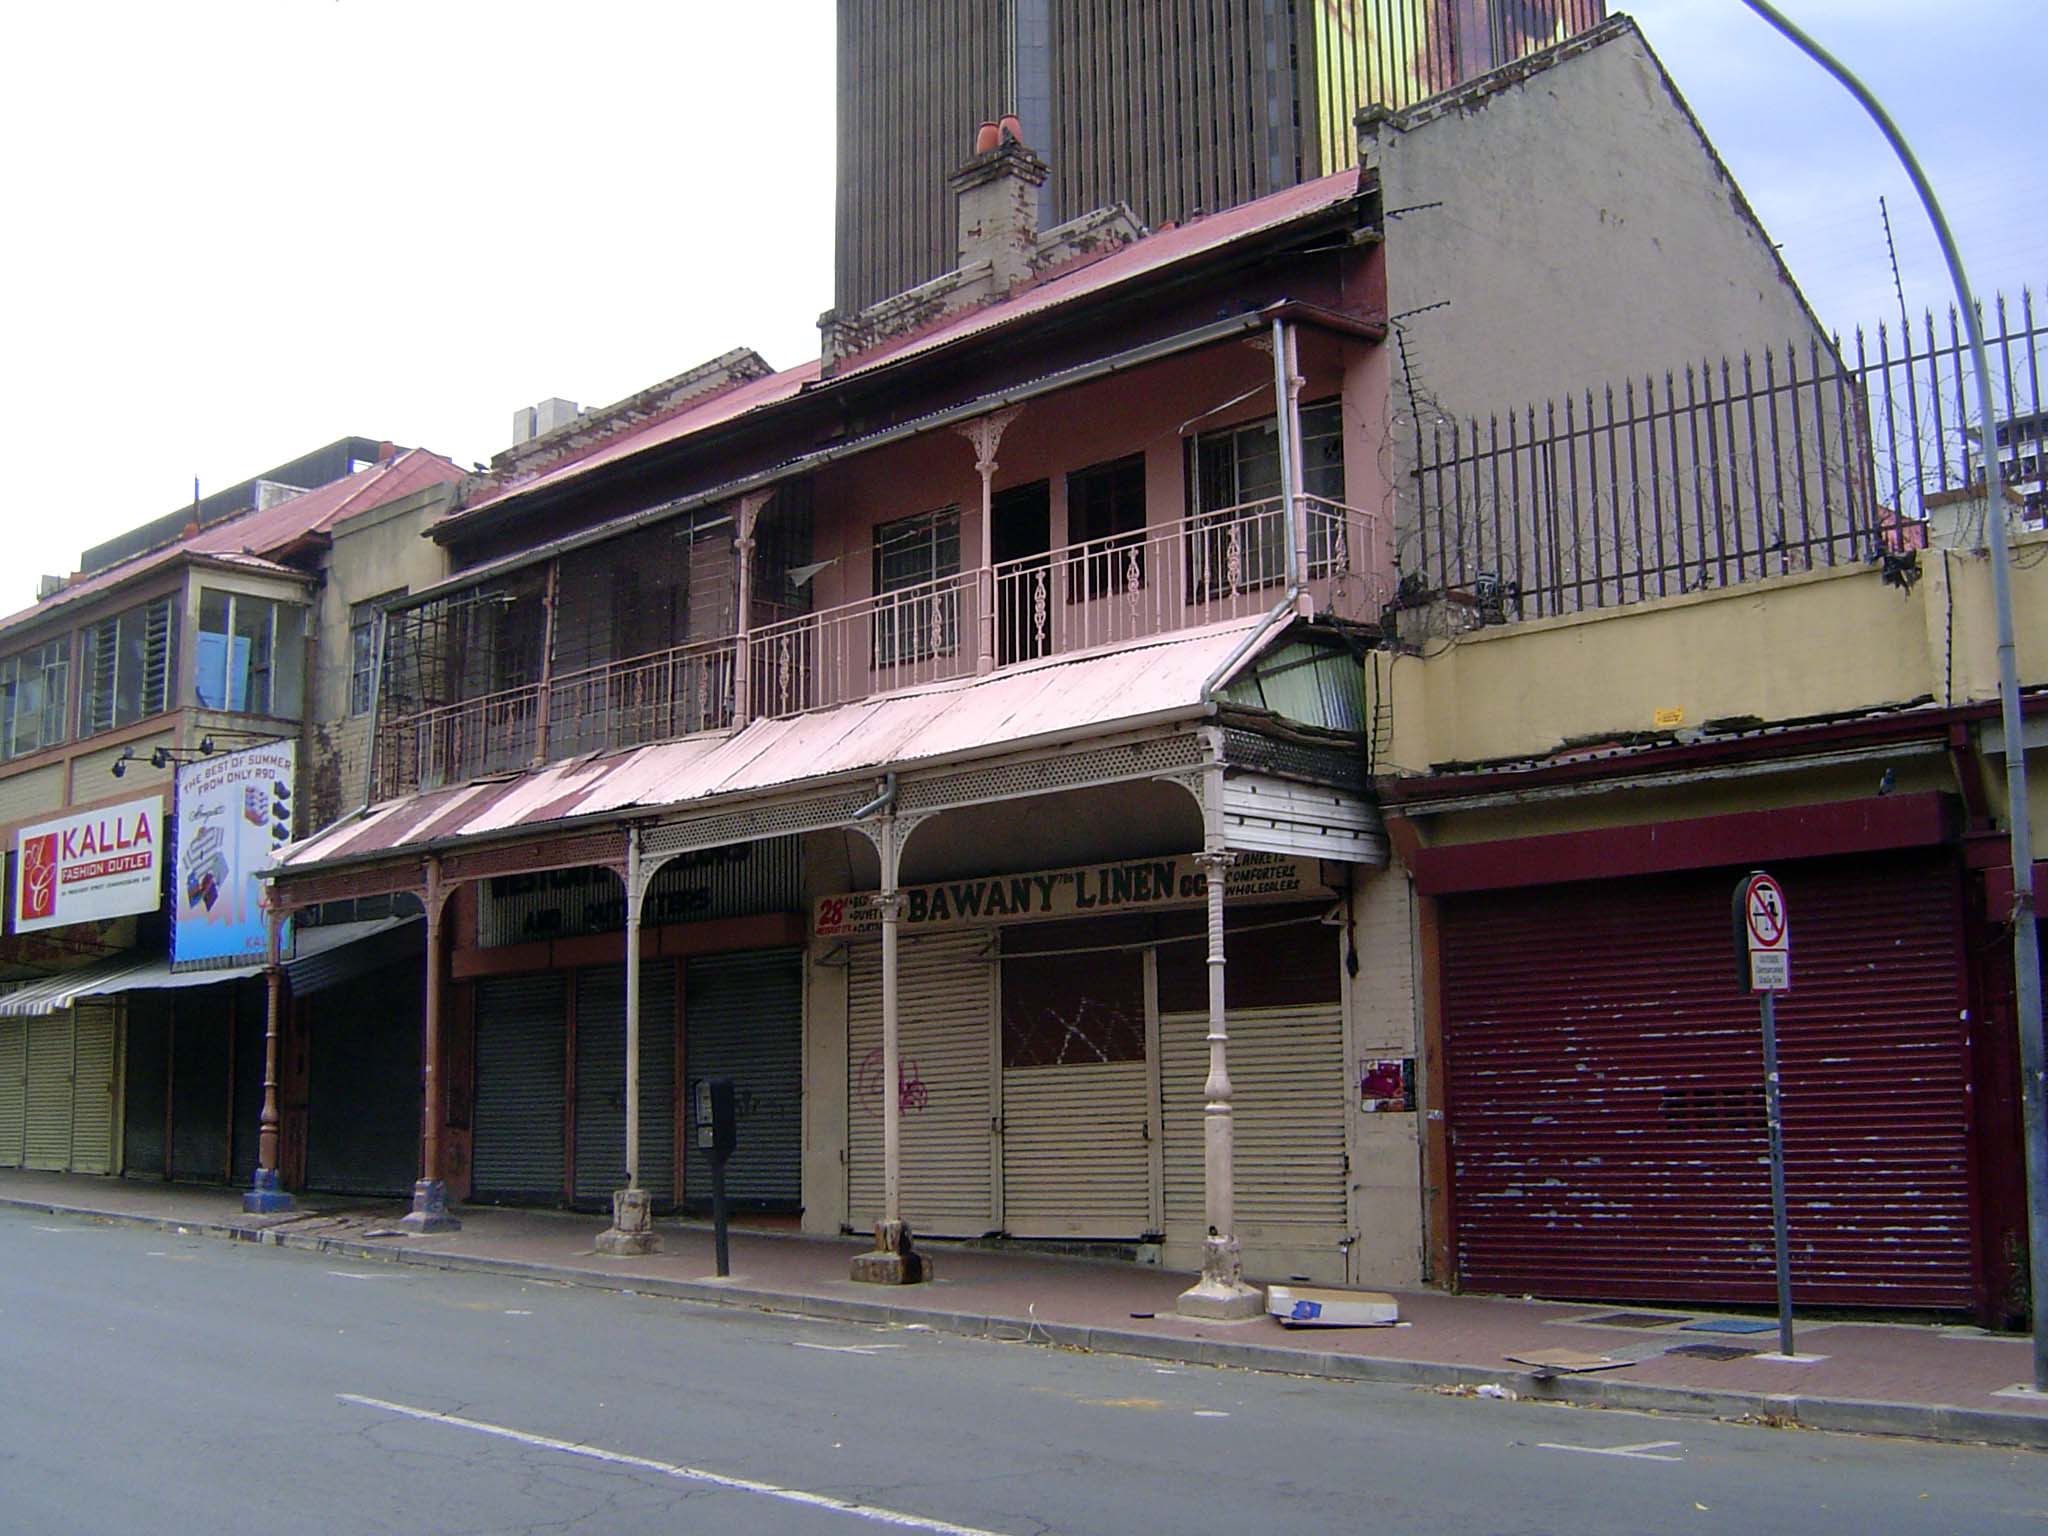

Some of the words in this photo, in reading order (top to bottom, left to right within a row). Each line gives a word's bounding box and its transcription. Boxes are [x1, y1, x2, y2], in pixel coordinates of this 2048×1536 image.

[184, 775, 202, 793] THE
[205, 761, 228, 779] BEST
[232, 755, 246, 769] OF
[248, 754, 292, 770] SUMMER
[198, 775, 224, 796] FROM
[227, 769, 251, 784] ONLY
[255, 768, 276, 780] R90
[62, 811, 153, 861] KALLA
[63, 863, 104, 881] FASHION
[108, 853, 151, 872] OUTLET
[1225, 865, 1297, 882] COMFORTERS
[907, 874, 1057, 923] BAWANY
[1076, 861, 1177, 908] LINEN
[819, 899, 843, 925] 28
